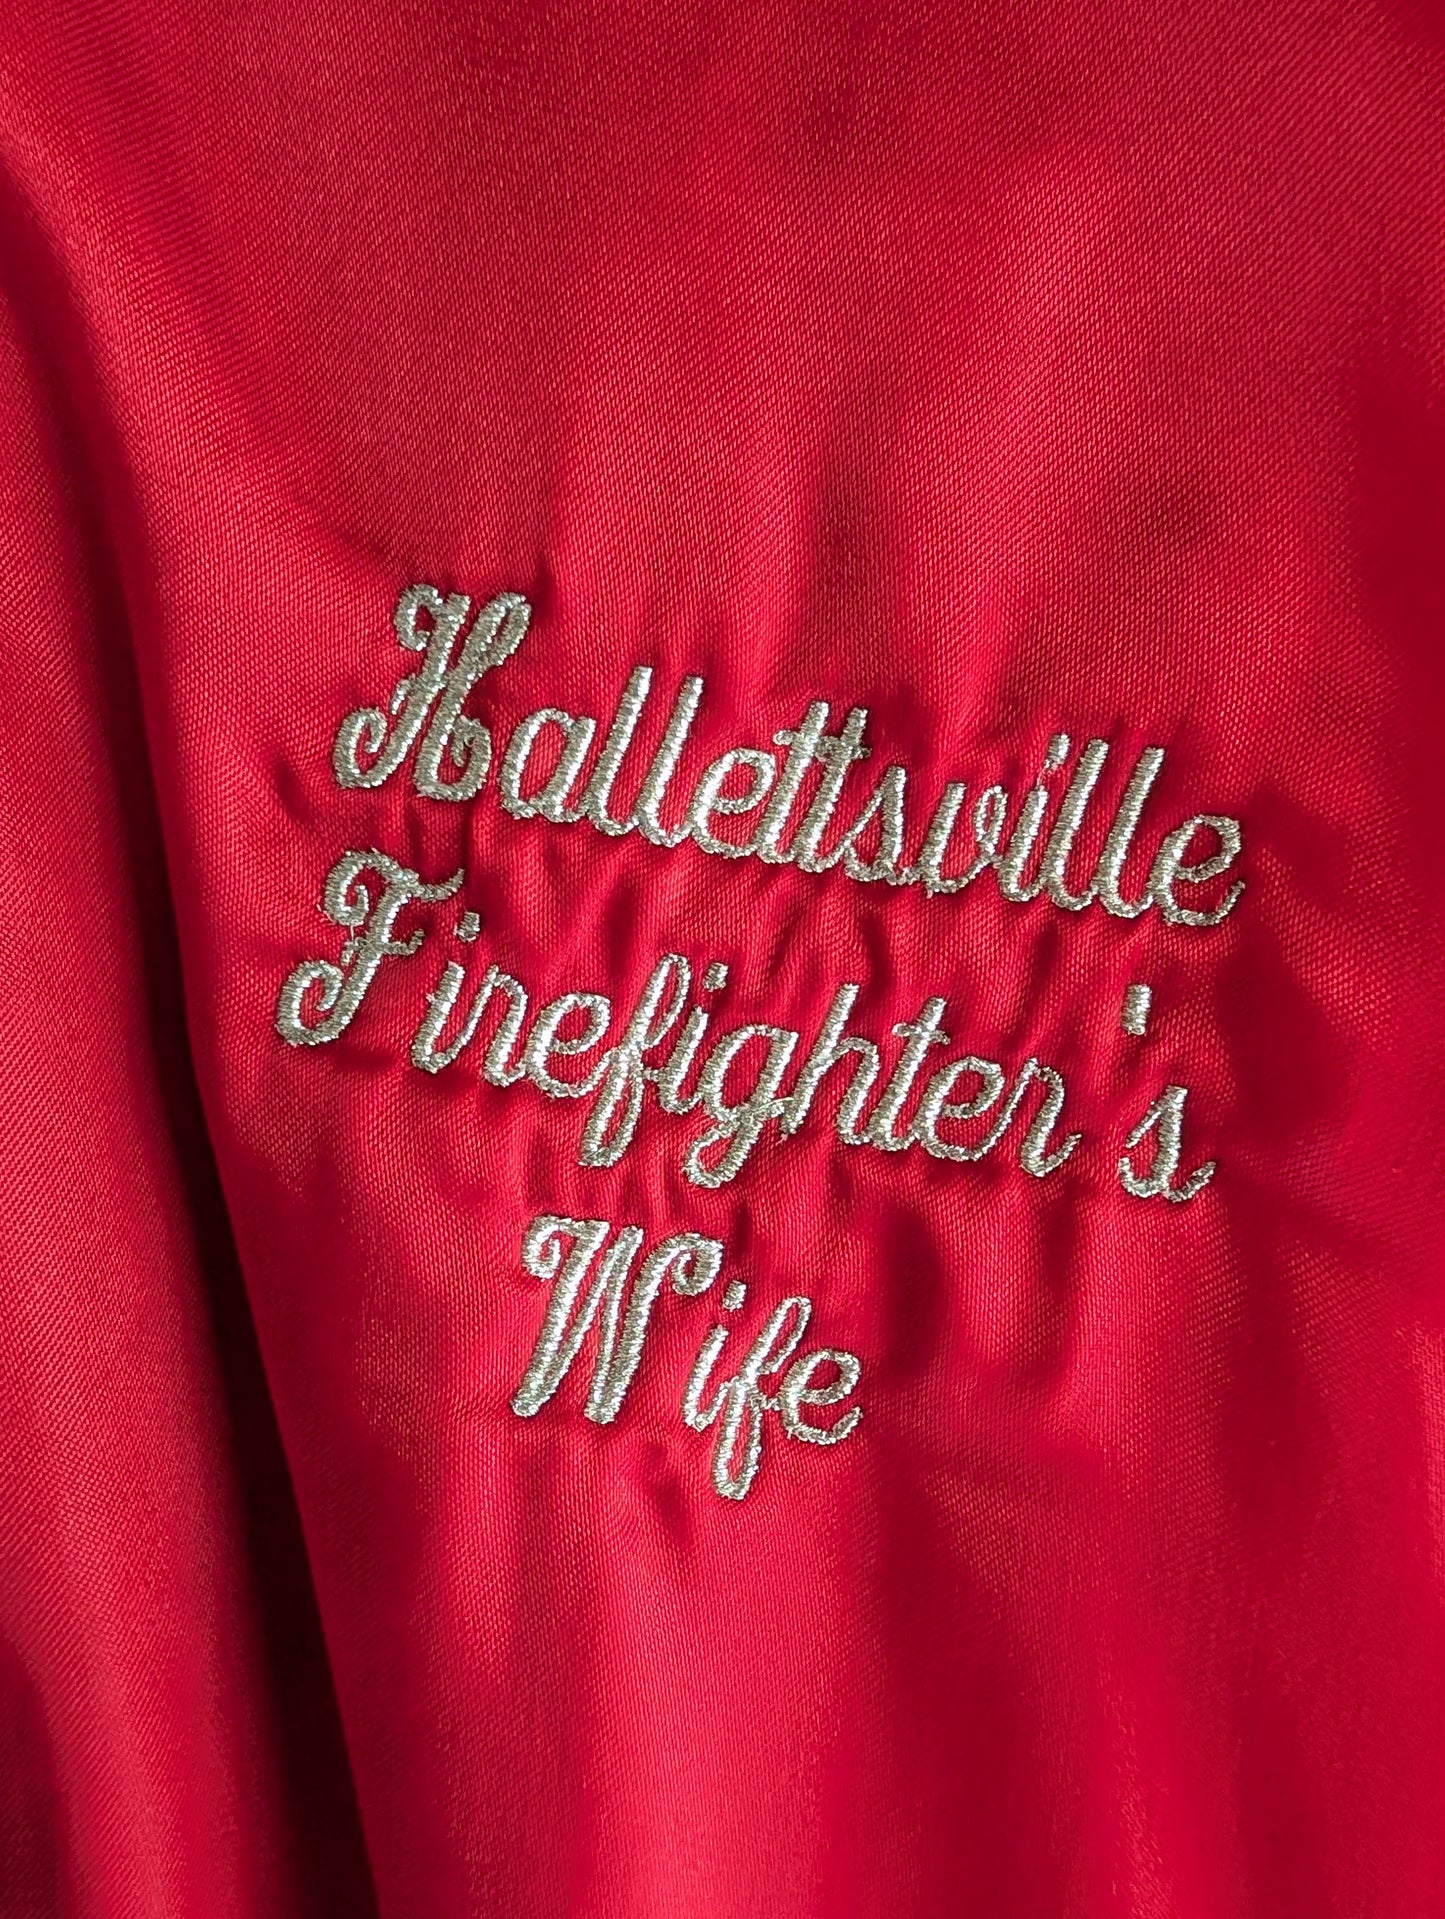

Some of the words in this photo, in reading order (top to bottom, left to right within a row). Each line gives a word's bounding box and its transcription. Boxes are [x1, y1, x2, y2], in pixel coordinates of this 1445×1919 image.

[333, 583, 1246, 927] Hallettsville
[275, 847, 1216, 1203] Firefighter's
[511, 1214, 863, 1501] Wife
